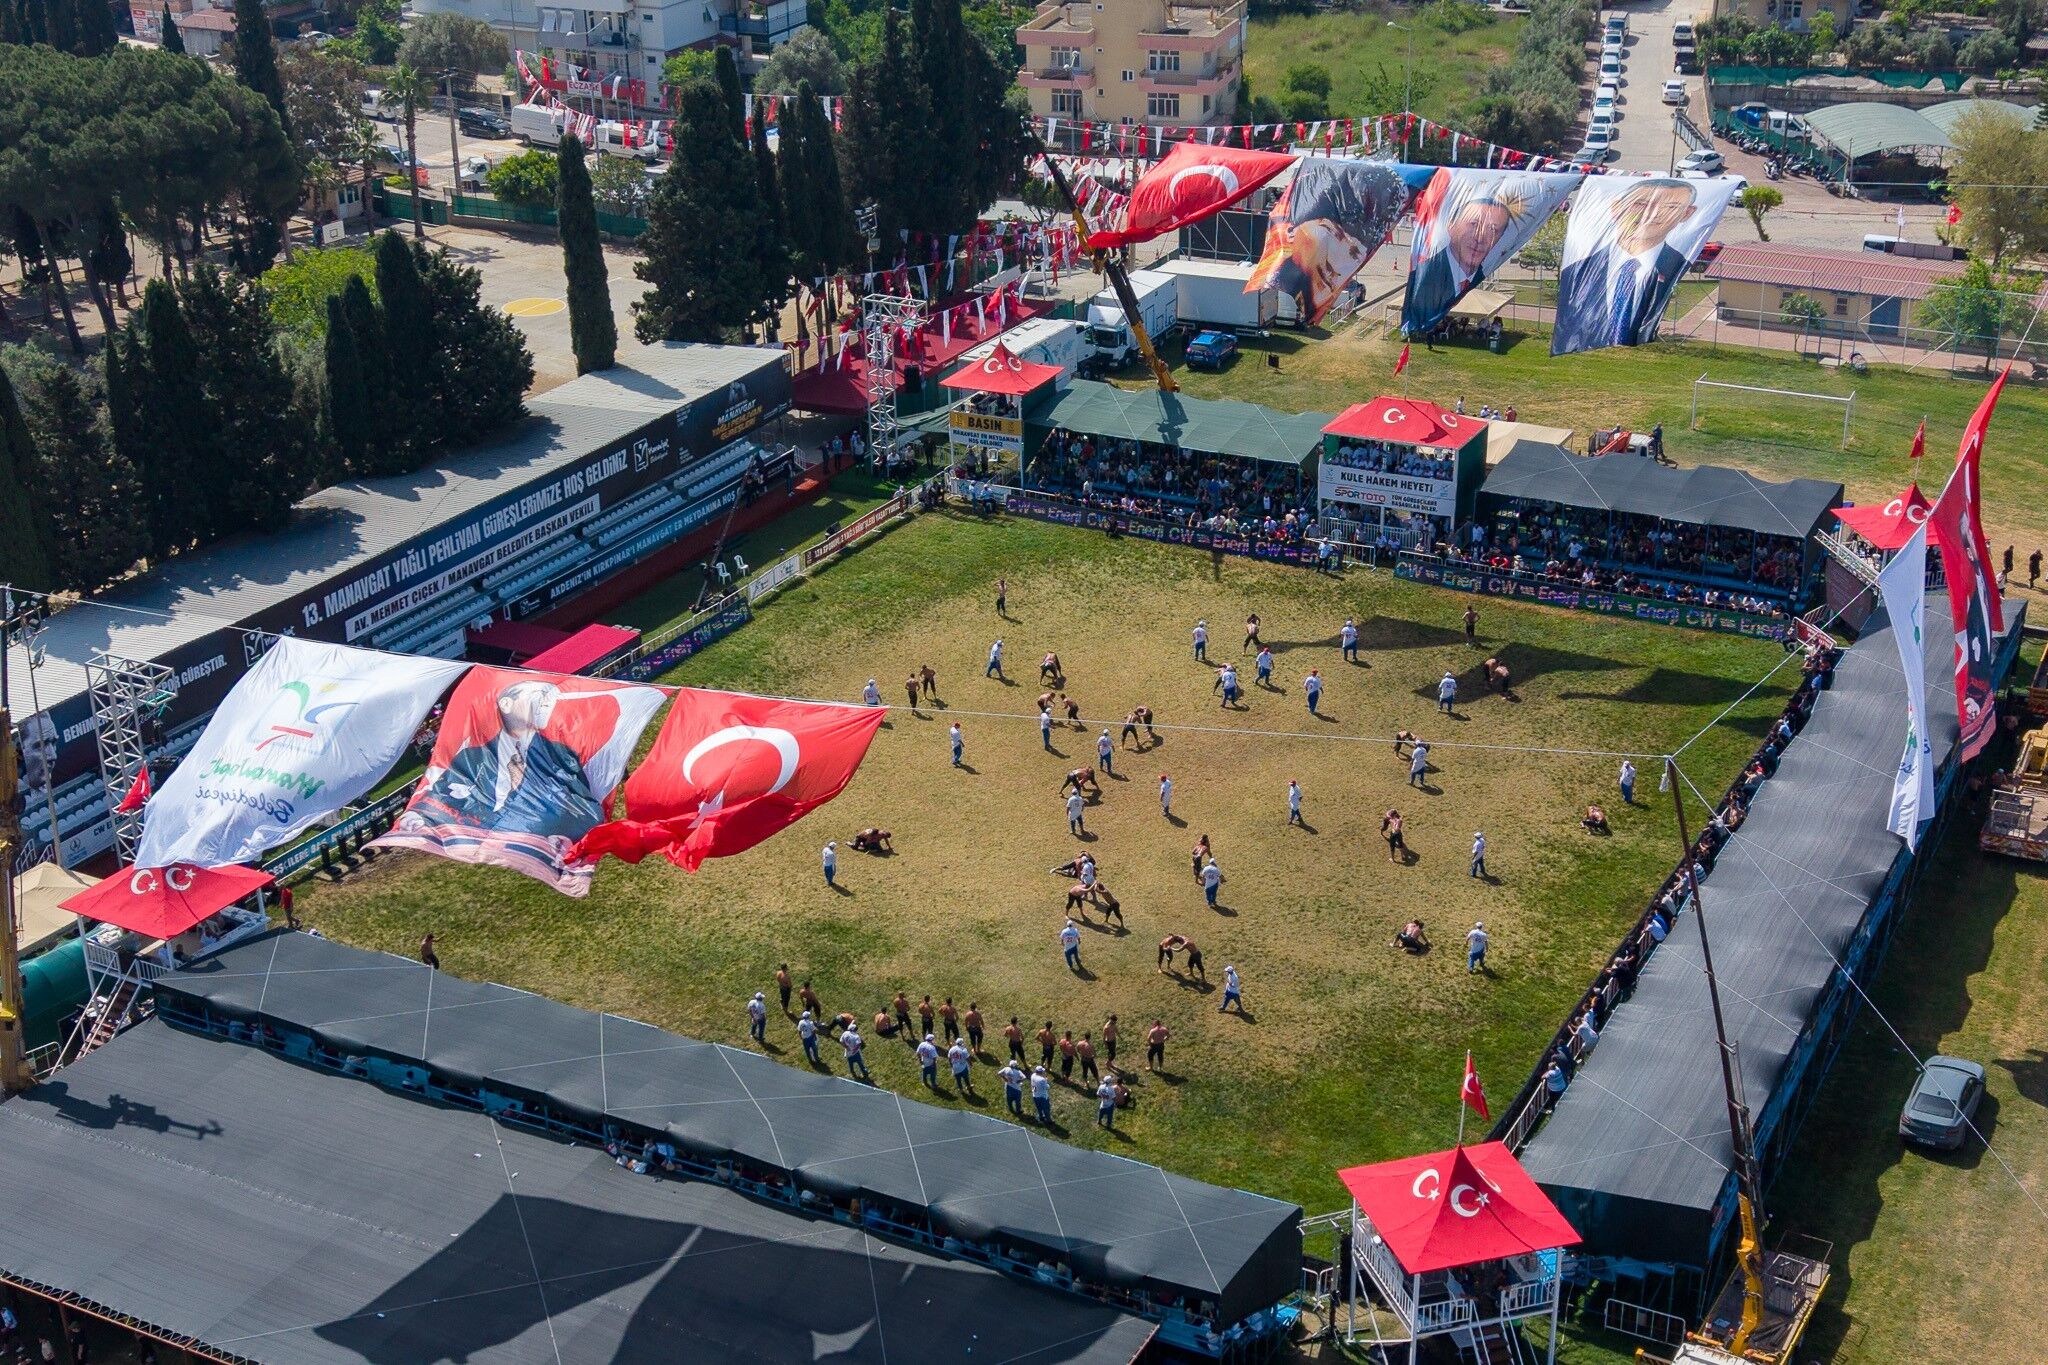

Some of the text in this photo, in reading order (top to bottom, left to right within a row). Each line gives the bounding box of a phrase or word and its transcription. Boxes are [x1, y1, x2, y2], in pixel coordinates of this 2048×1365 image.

[967, 416, 1002, 431] BASIN
[1340, 471, 1364, 483] KULE
[1366, 475, 1398, 489] HAKEM
[301, 602, 323, 628] 13.
[323, 565, 393, 618] MANAVGAT
[393, 548, 427, 582] YAĞLI
[563, 475, 585, 499] HOŞ
[353, 617, 370, 635] AV.
[370, 597, 410, 625] MEHMET
[448, 554, 500, 585] MANAVGAT
[535, 514, 568, 542] BAŞKAN
[1488, 577, 1517, 595] CW
